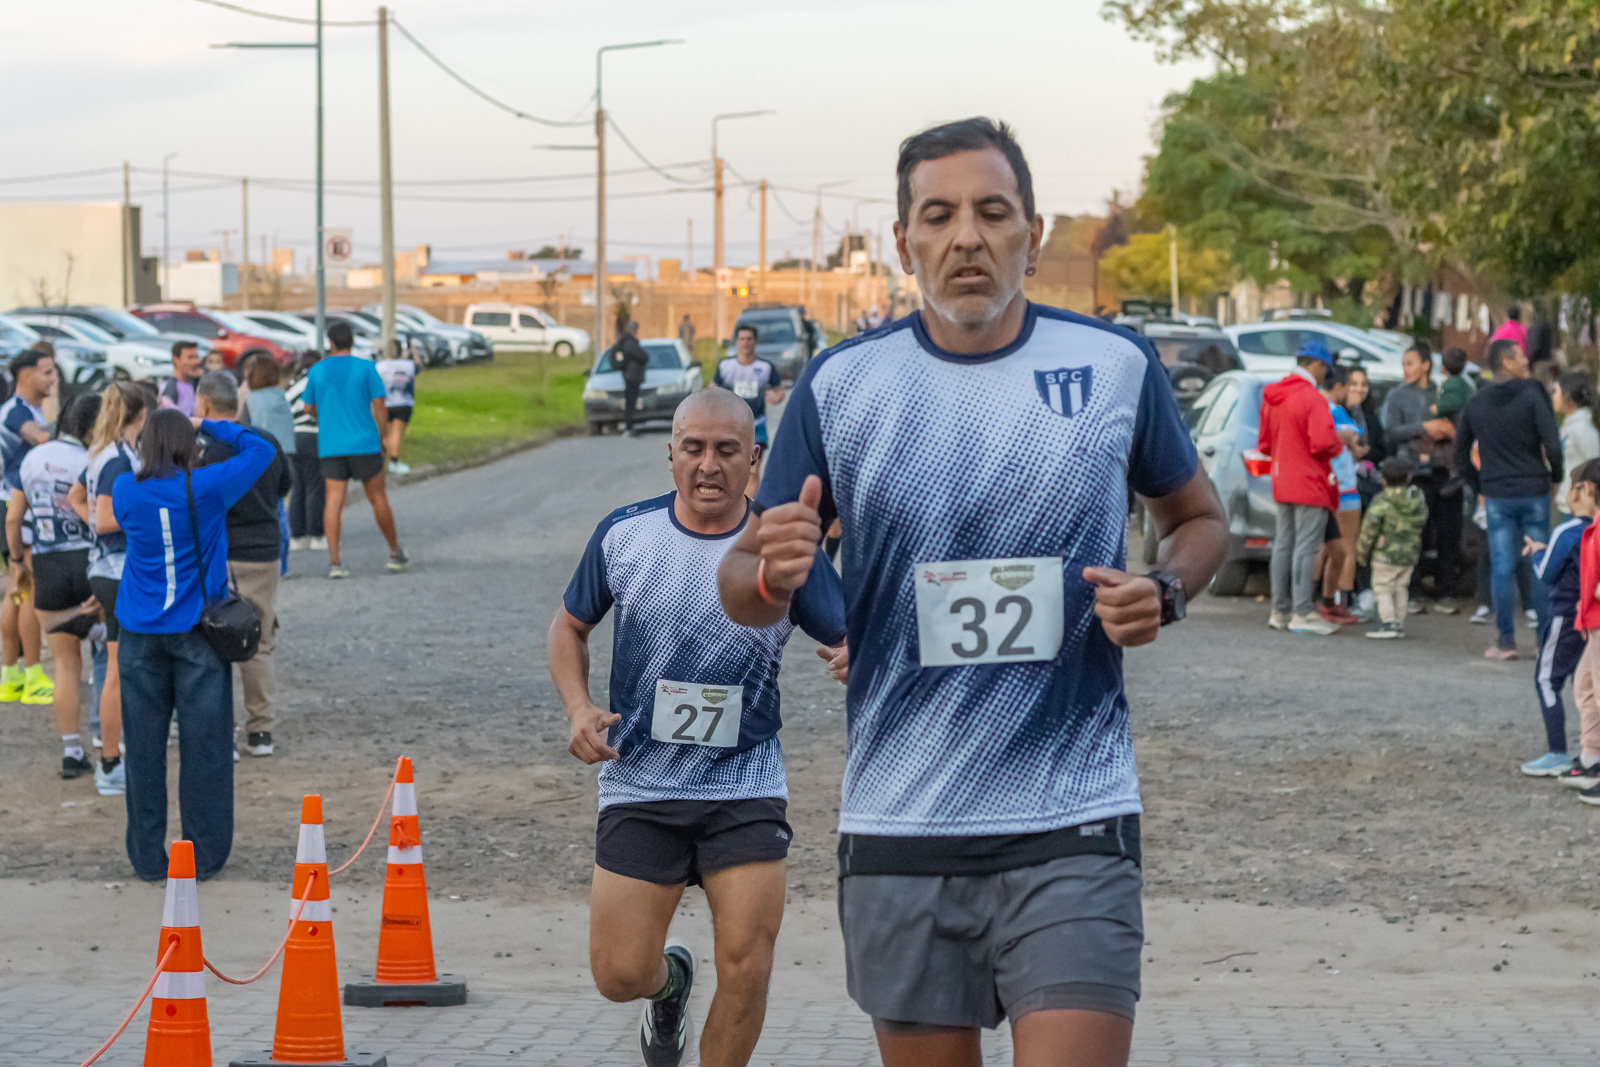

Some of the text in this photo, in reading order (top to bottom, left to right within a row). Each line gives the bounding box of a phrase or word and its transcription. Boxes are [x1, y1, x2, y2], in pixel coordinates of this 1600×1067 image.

[1045, 371, 1083, 384] SFC
[949, 594, 1035, 659] 32
[671, 703, 724, 743] 27
